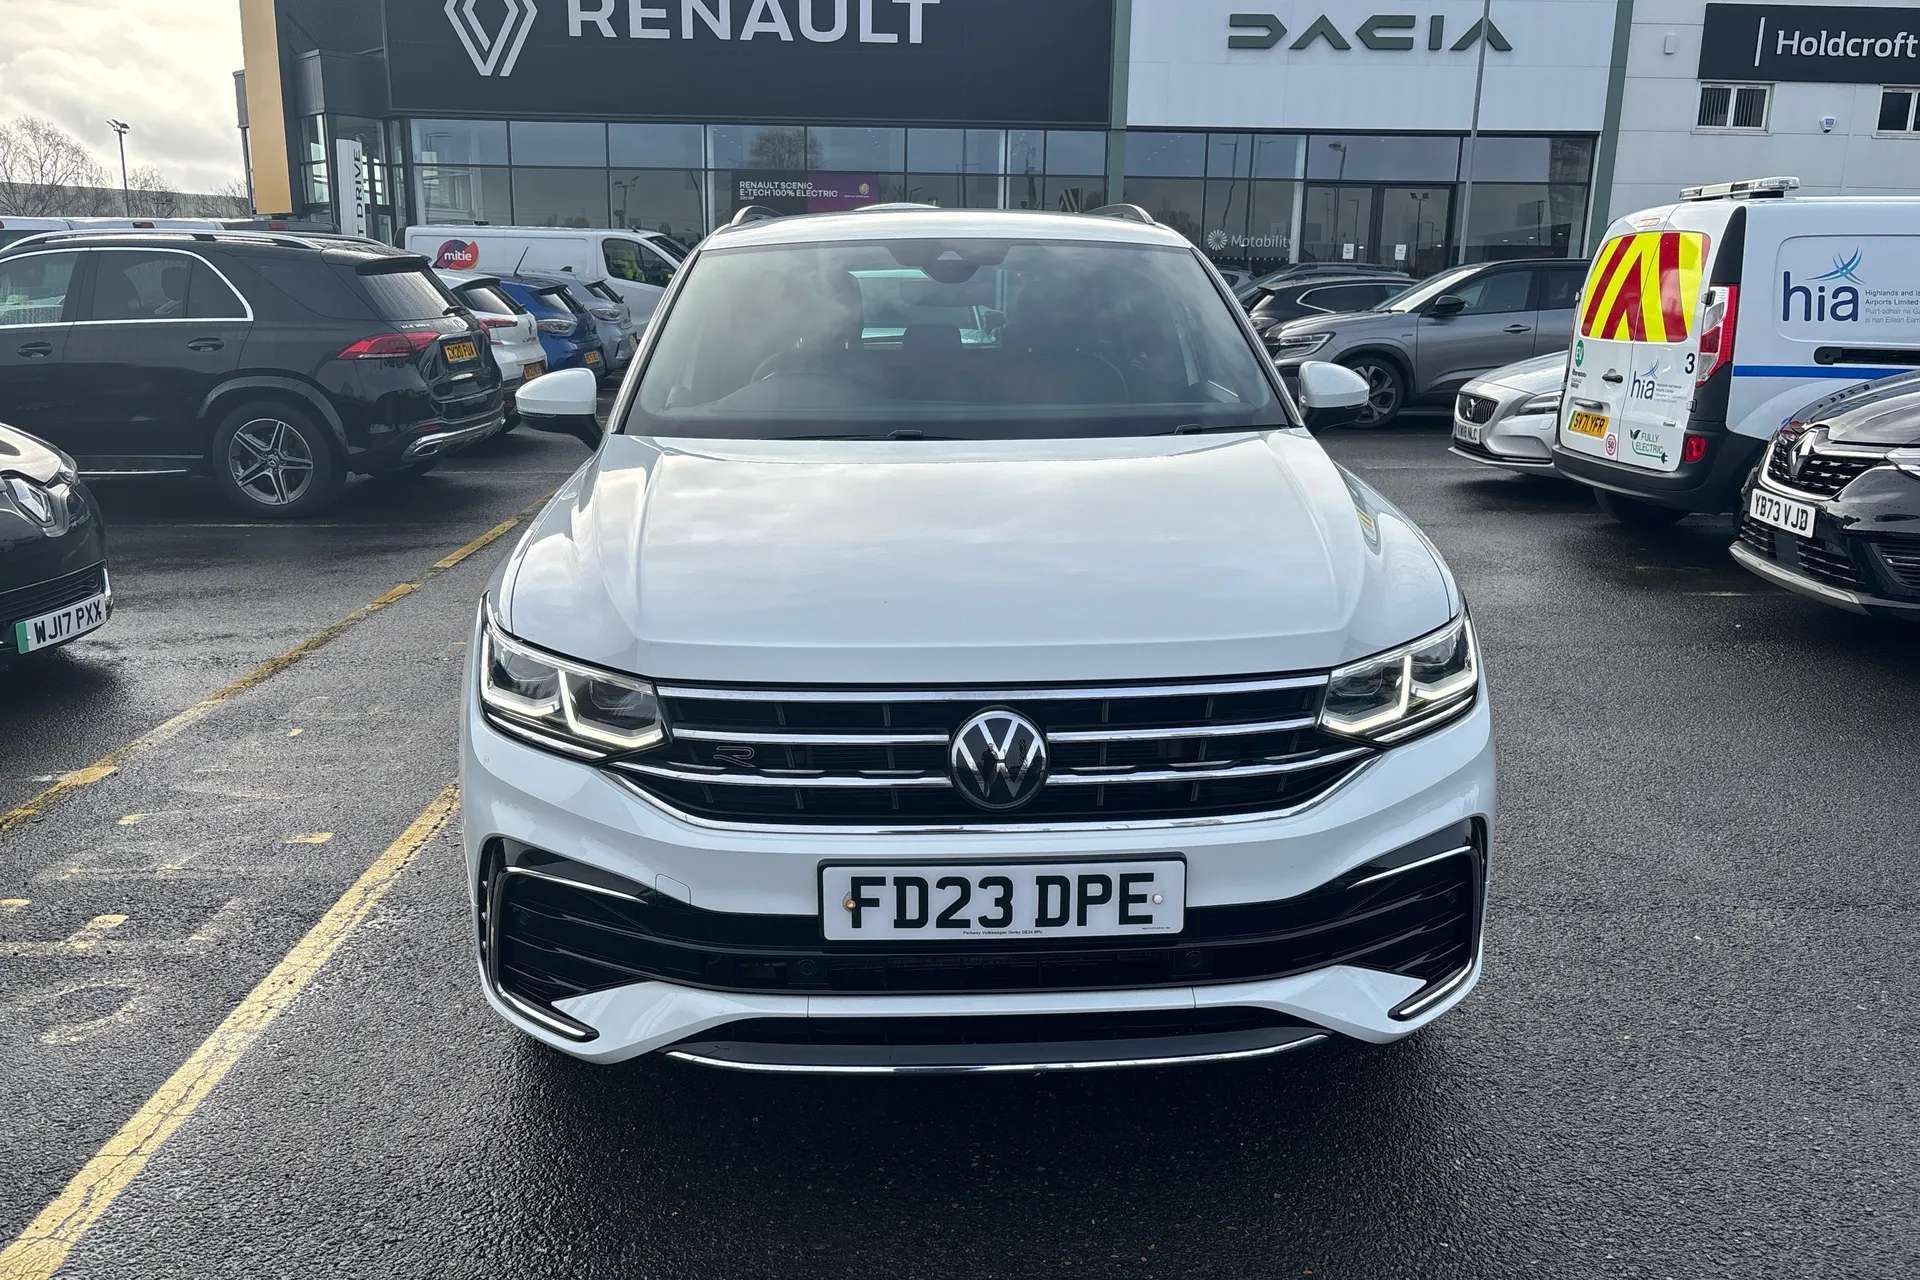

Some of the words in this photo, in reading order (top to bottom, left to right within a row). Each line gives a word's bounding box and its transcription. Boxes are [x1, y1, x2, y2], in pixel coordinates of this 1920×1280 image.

[568, 0, 940, 44] RENAULT
[1228, 14, 1513, 51] DACIA
[1776, 30, 1918, 58] Holdcroft
[354, 148, 364, 218] DRIVE
[740, 181, 779, 190] RENAULT
[780, 182, 813, 190] SCENIC
[772, 189, 795, 197] 100%
[796, 190, 838, 198] ELECTRIC
[444, 250, 472, 261] mitie
[1783, 271, 1859, 321] hia
[1865, 289, 1899, 297] Highlands
[1685, 353, 1695, 374] 3
[1630, 371, 1655, 400] hia
[1636, 442, 1663, 454] ELECTRIC
[1641, 432, 1660, 443] FULLY
[1755, 493, 1780, 522] YB73
[1784, 504, 1808, 531] VJD
[34, 611, 72, 644] WJ17
[76, 600, 102, 630] PXX
[850, 876, 1014, 929] FD23
[1034, 872, 1155, 928] DPE
